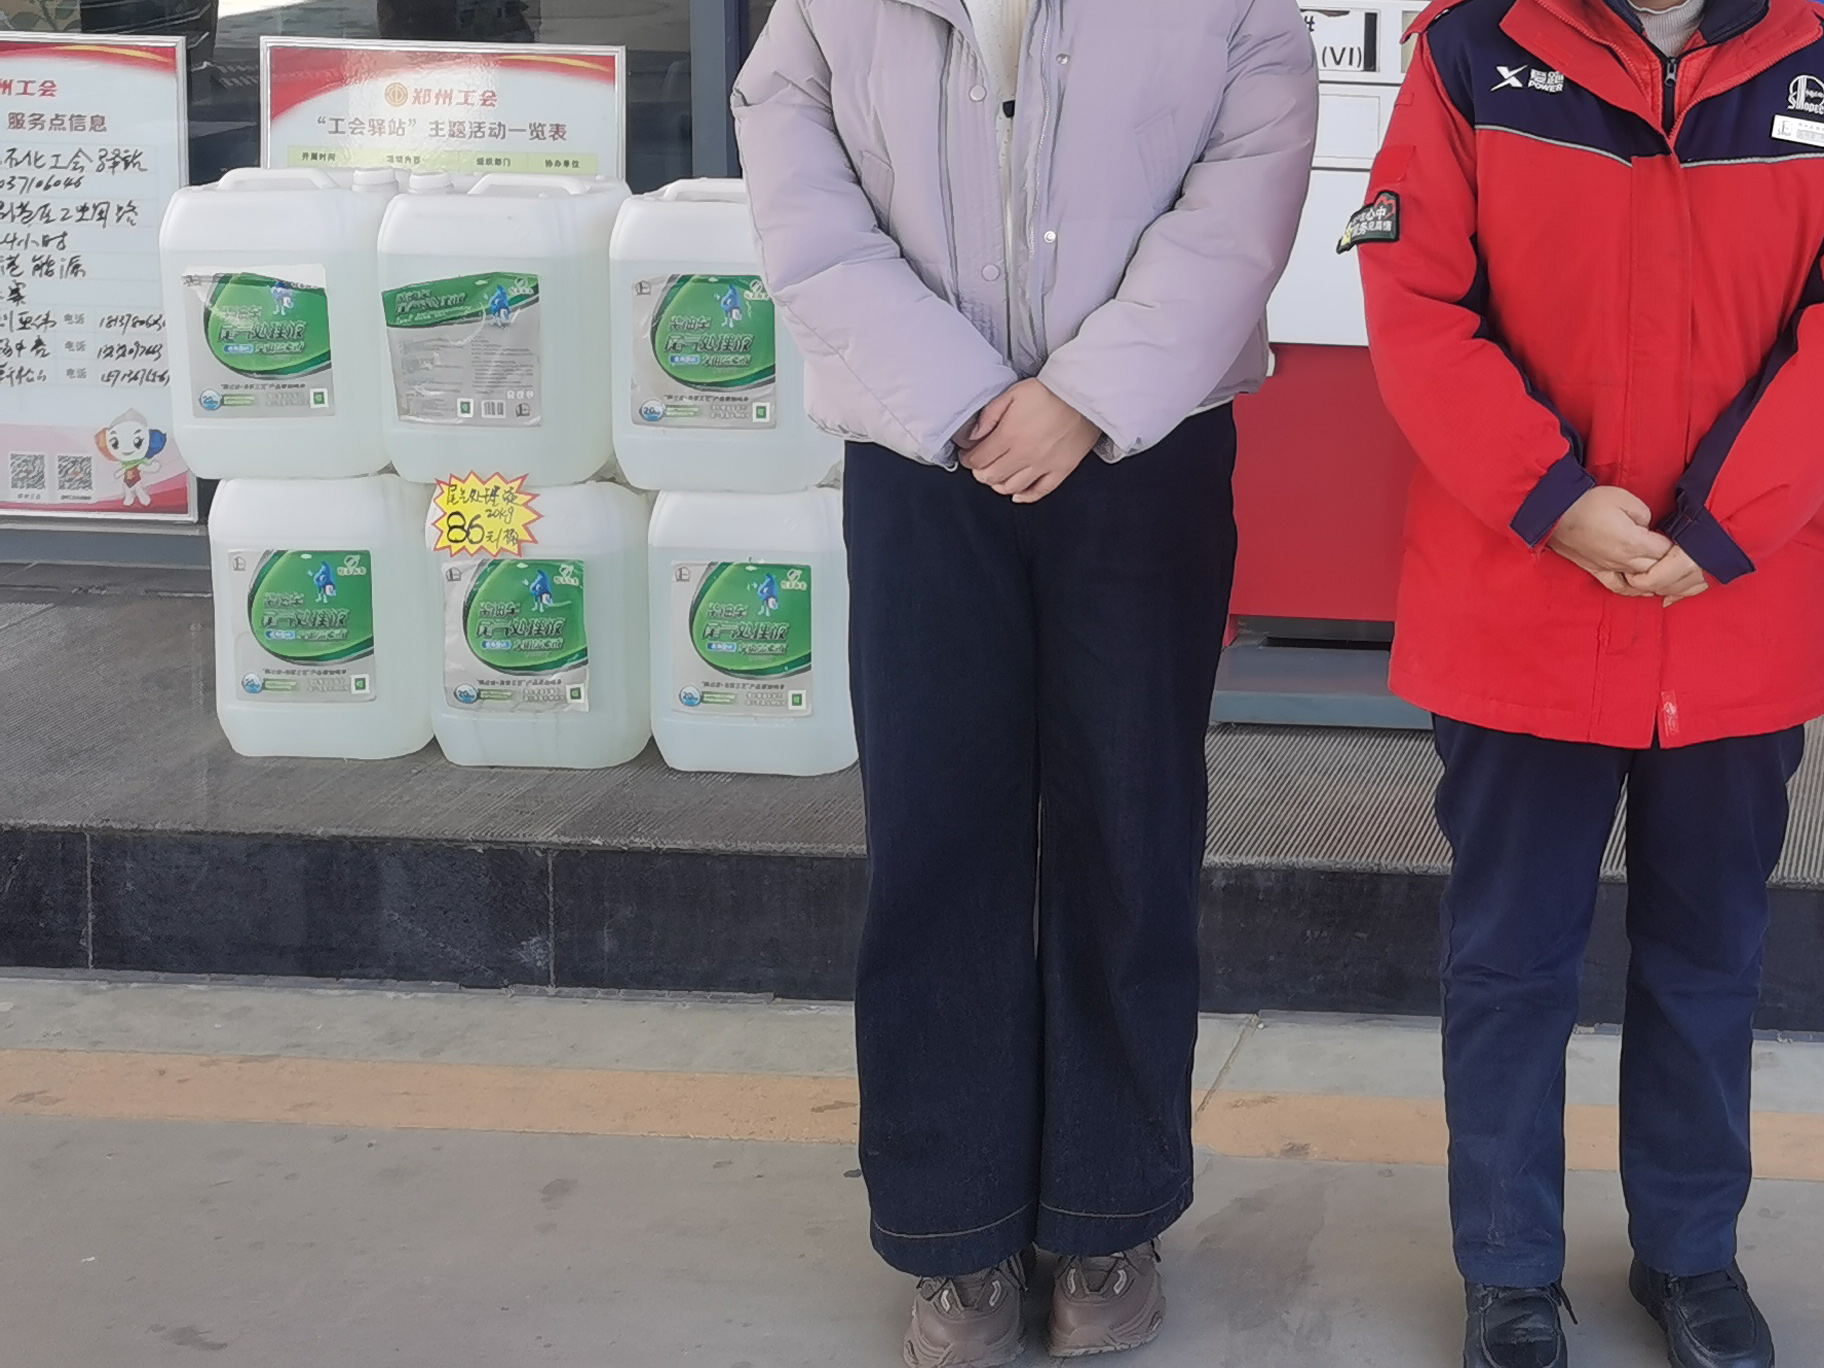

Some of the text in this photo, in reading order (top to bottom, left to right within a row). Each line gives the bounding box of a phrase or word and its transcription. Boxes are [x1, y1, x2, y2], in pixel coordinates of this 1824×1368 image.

[1528, 80, 1563, 93] POWER
[411, 88, 498, 107] 郑州工会
[7, 112, 107, 133] 服务点信息
[544, 159, 580, 169] 协办单位
[446, 511, 485, 544] 86
